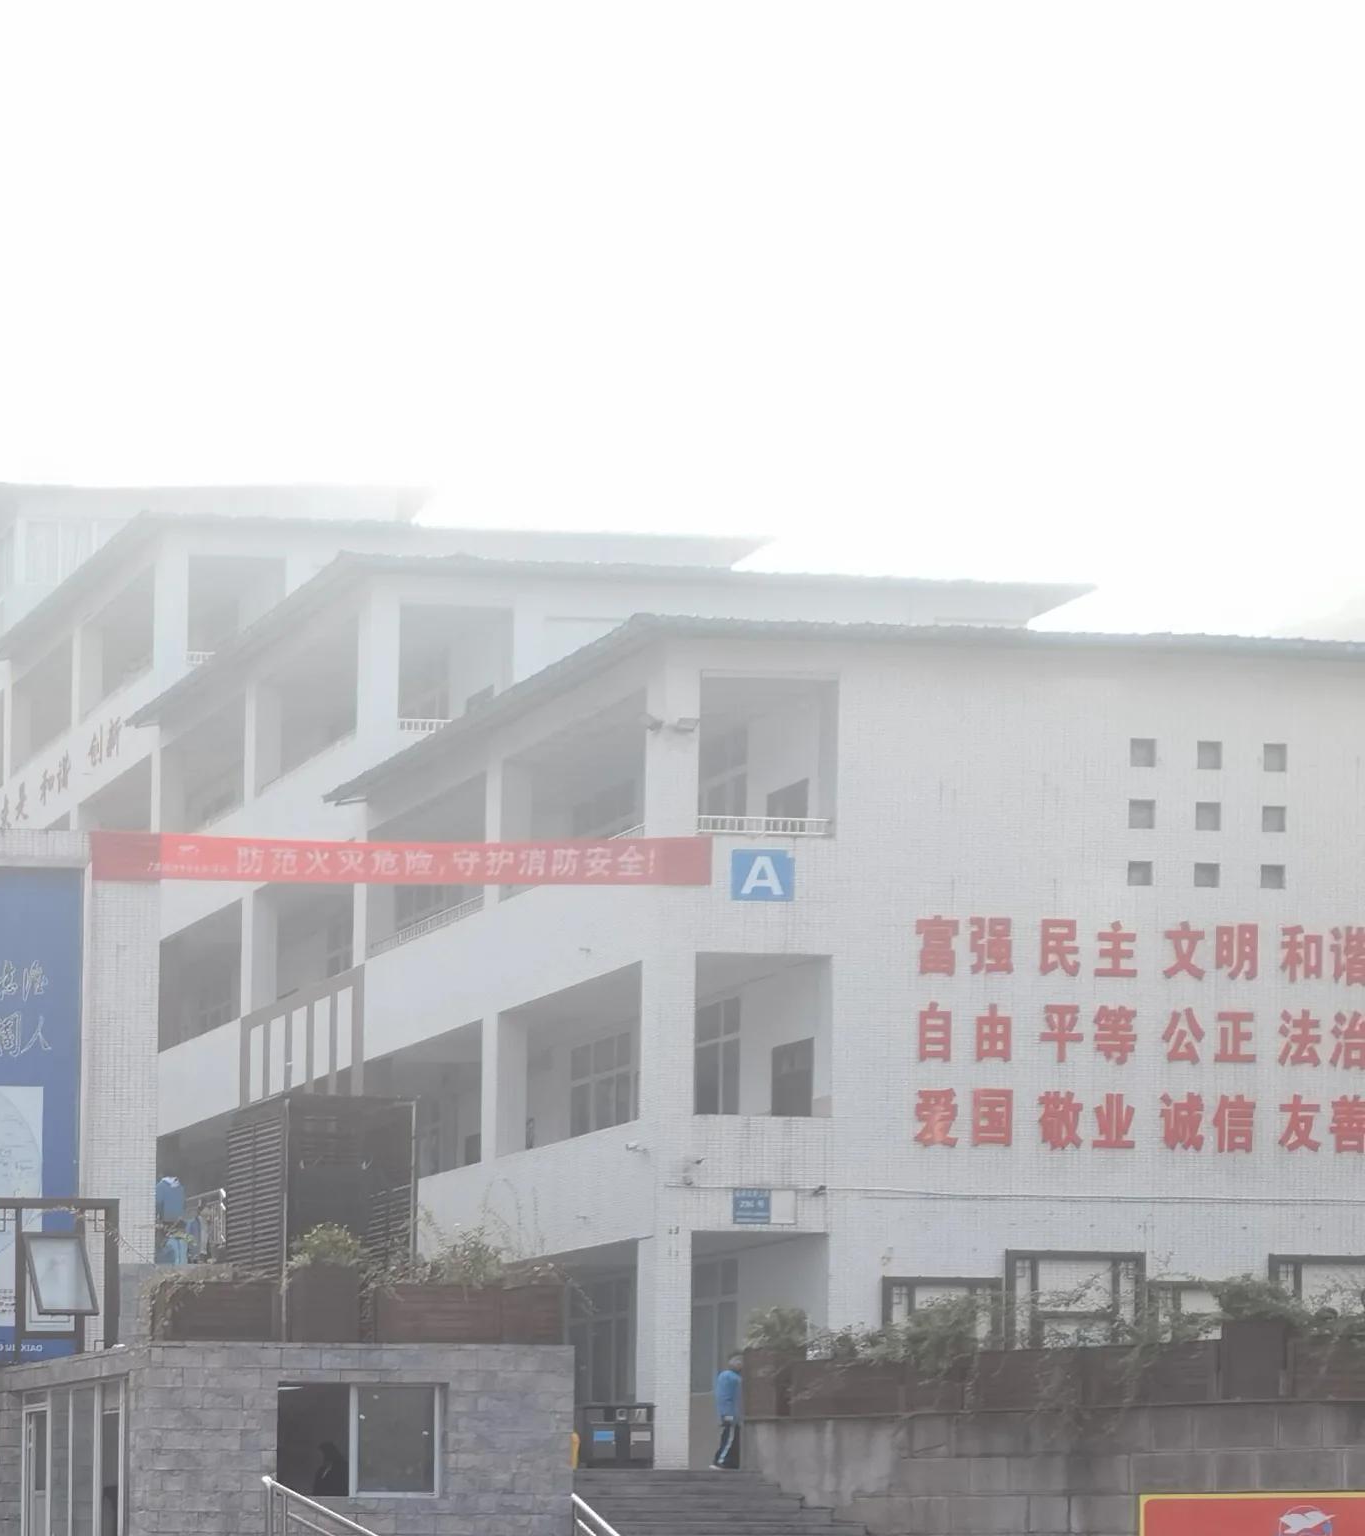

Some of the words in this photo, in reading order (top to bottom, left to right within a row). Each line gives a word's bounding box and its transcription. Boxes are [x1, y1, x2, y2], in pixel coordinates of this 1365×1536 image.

[741, 855, 784, 895] A
[915, 915, 1015, 976] 富强
[1039, 918, 1138, 978] 民主
[1162, 920, 1259, 981] 文明
[1279, 924, 1365, 986] 和谐
[917, 1002, 1012, 1063] 自由
[1039, 1003, 1138, 1065] 平等
[1161, 1007, 1257, 1065] 公正
[1278, 1009, 1365, 1070] 法治
[913, 1088, 1014, 1149] 爱国
[1038, 1090, 1136, 1151] 敬业
[1159, 1091, 1257, 1154] 诚信
[1278, 1093, 1365, 1154] 友善
